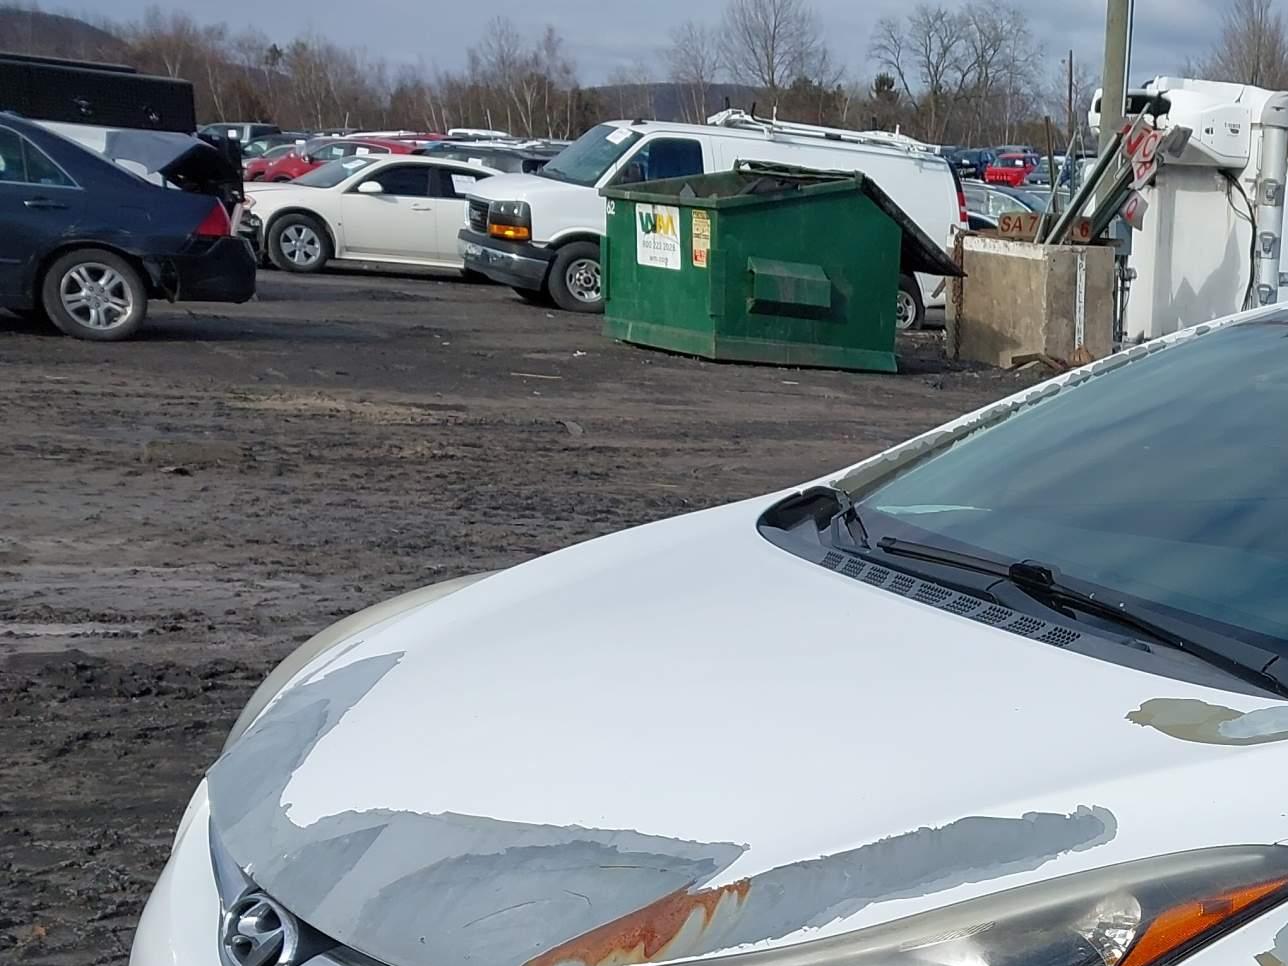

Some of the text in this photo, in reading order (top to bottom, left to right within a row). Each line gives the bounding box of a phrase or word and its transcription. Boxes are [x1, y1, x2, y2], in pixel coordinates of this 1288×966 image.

[1001, 214, 1039, 234] SA 7
[1079, 219, 1090, 238] 6
